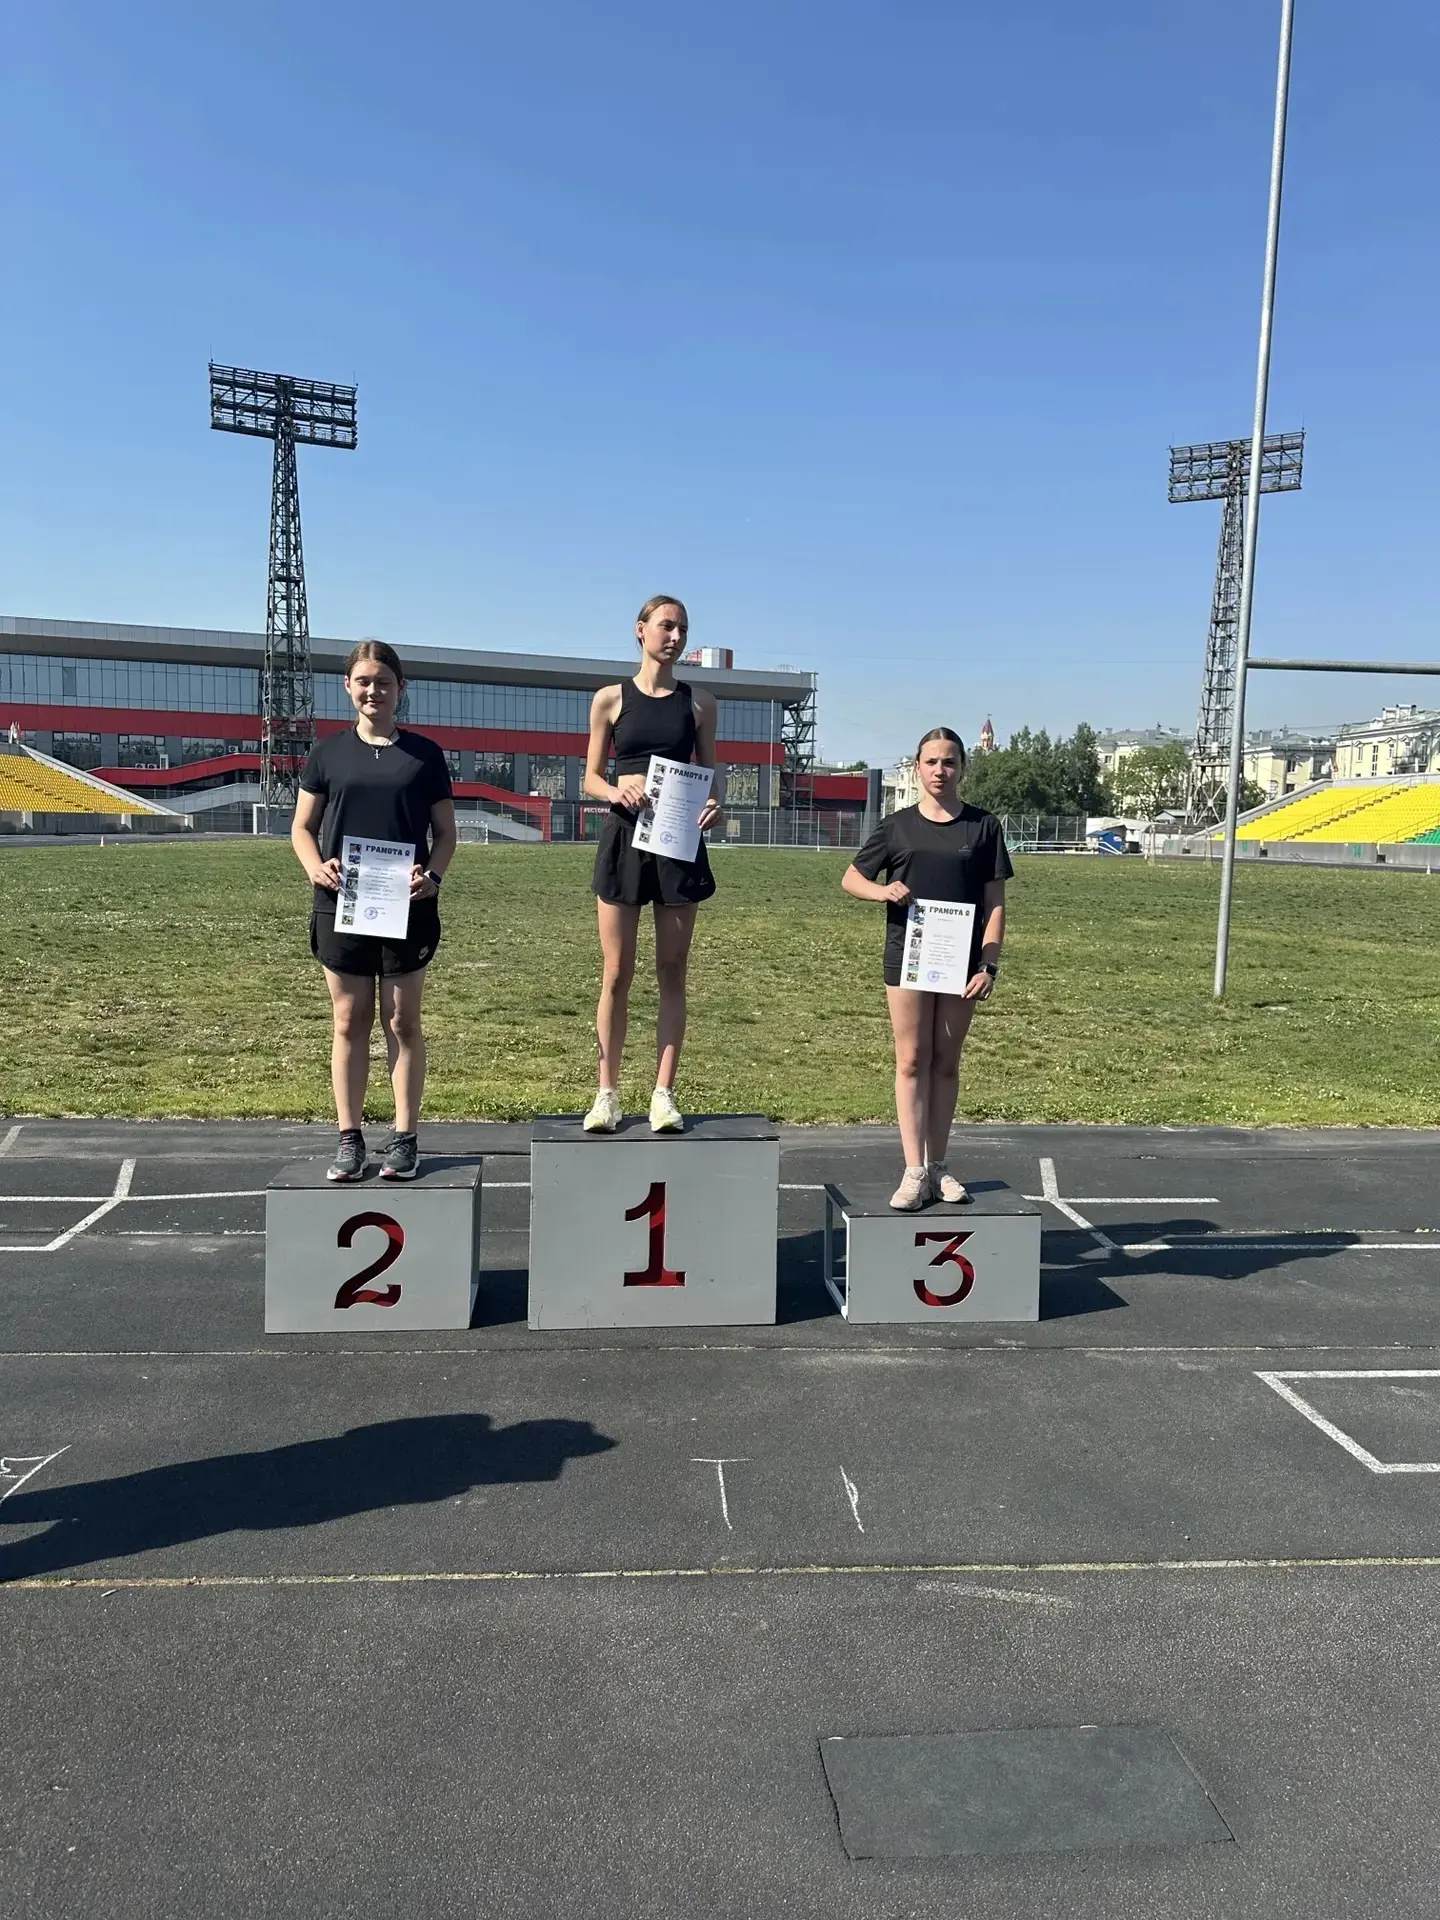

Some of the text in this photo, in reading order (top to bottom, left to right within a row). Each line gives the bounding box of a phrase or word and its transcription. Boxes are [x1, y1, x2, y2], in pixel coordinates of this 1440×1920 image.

[670, 767, 702, 780] ГРАМОТА
[365, 845, 403, 857] ГРАМОТА
[930, 906, 963, 916] ГРАМОТА
[623, 1182, 686, 1287] 1
[334, 1211, 405, 1310] 2
[913, 1231, 976, 1307] 3
